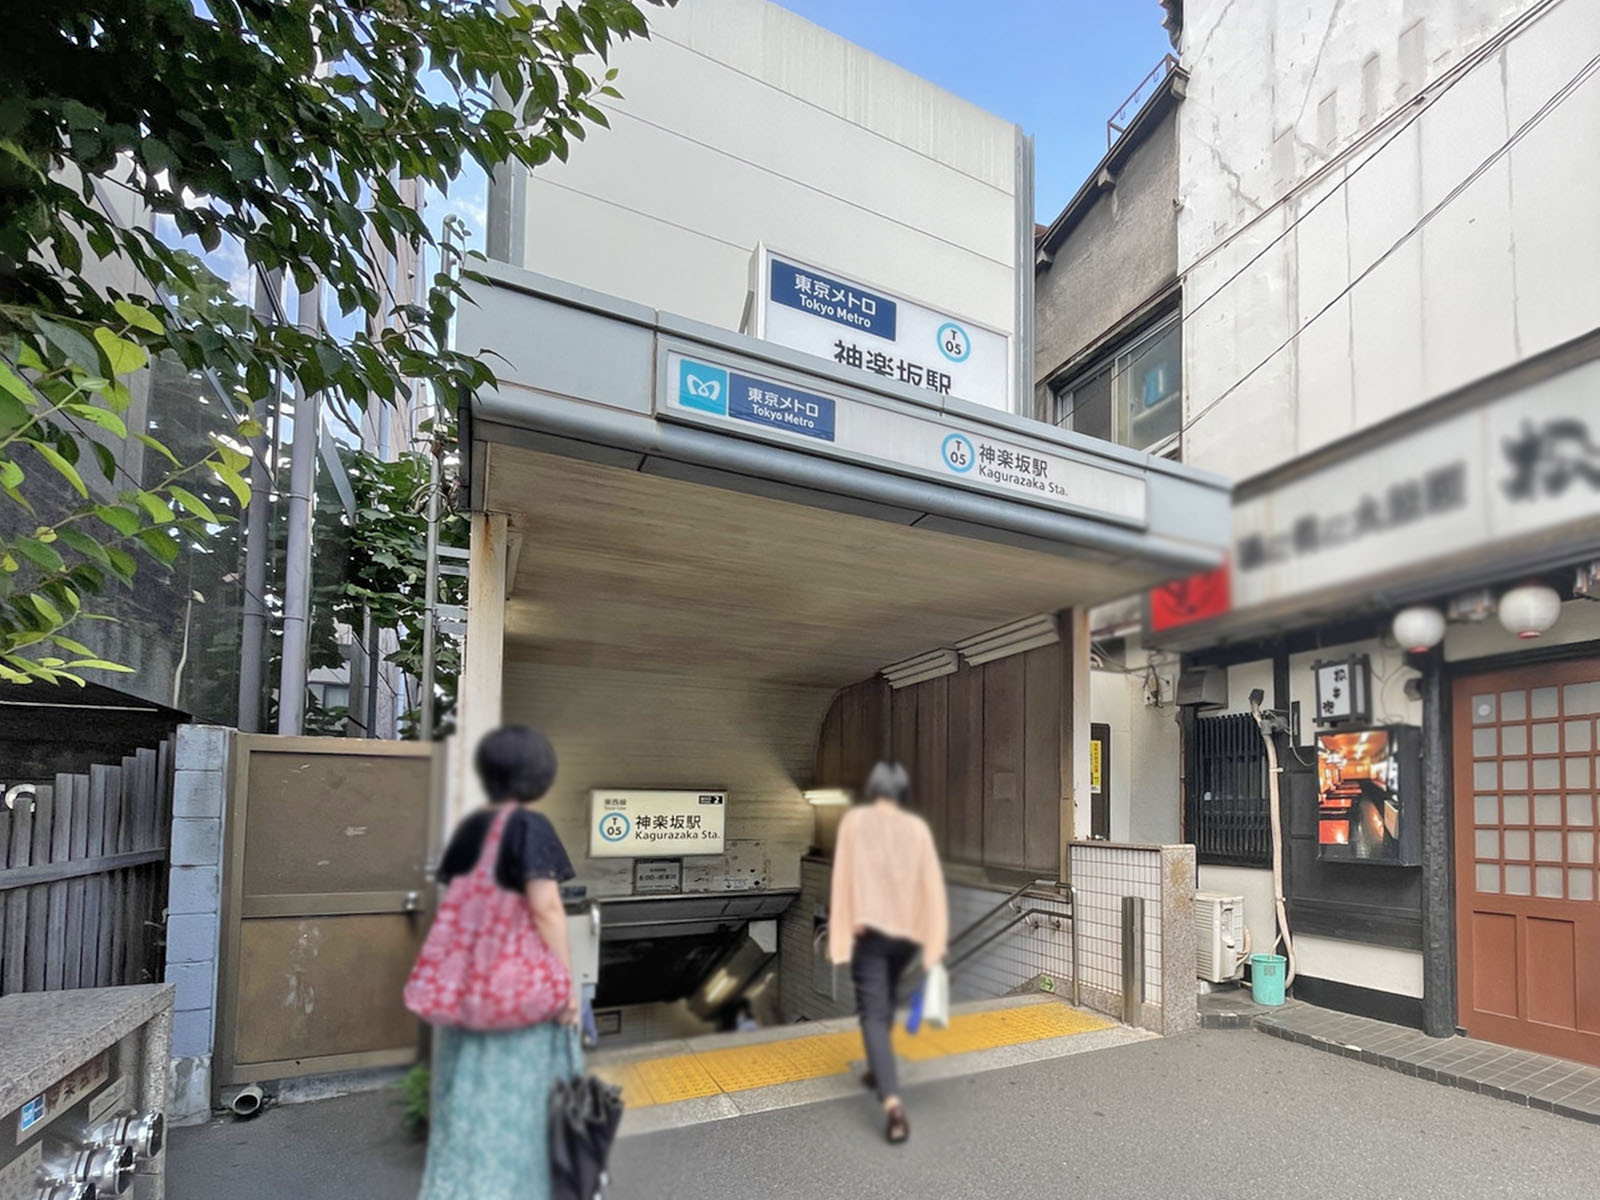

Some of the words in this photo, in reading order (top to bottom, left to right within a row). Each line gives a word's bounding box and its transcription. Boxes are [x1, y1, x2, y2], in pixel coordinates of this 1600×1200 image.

[795, 273, 876, 316] 東京メトロ
[799, 294, 835, 317] Tokyo
[837, 306, 872, 328] Metro
[949, 329, 958, 341] T
[945, 340, 962, 356] 05
[834, 339, 952, 396] 神楽坂駅
[748, 386, 819, 418] 東京メトロ
[752, 404, 783, 421] Tokyo
[784, 413, 815, 429] Metro
[955, 440, 962, 451] T
[950, 451, 966, 465] 05
[979, 443, 1048, 479] 神楽坂駅
[979, 465, 1045, 491] Kagurazaka
[1048, 482, 1069, 497] Sta.
[714, 796, 721, 804] 2
[612, 817, 618, 826] T
[635, 815, 702, 830] 神楽坂駅
[607, 826, 622, 836] 05
[635, 831, 699, 842] Kagurazaka
[702, 830, 721, 839] Sta.
